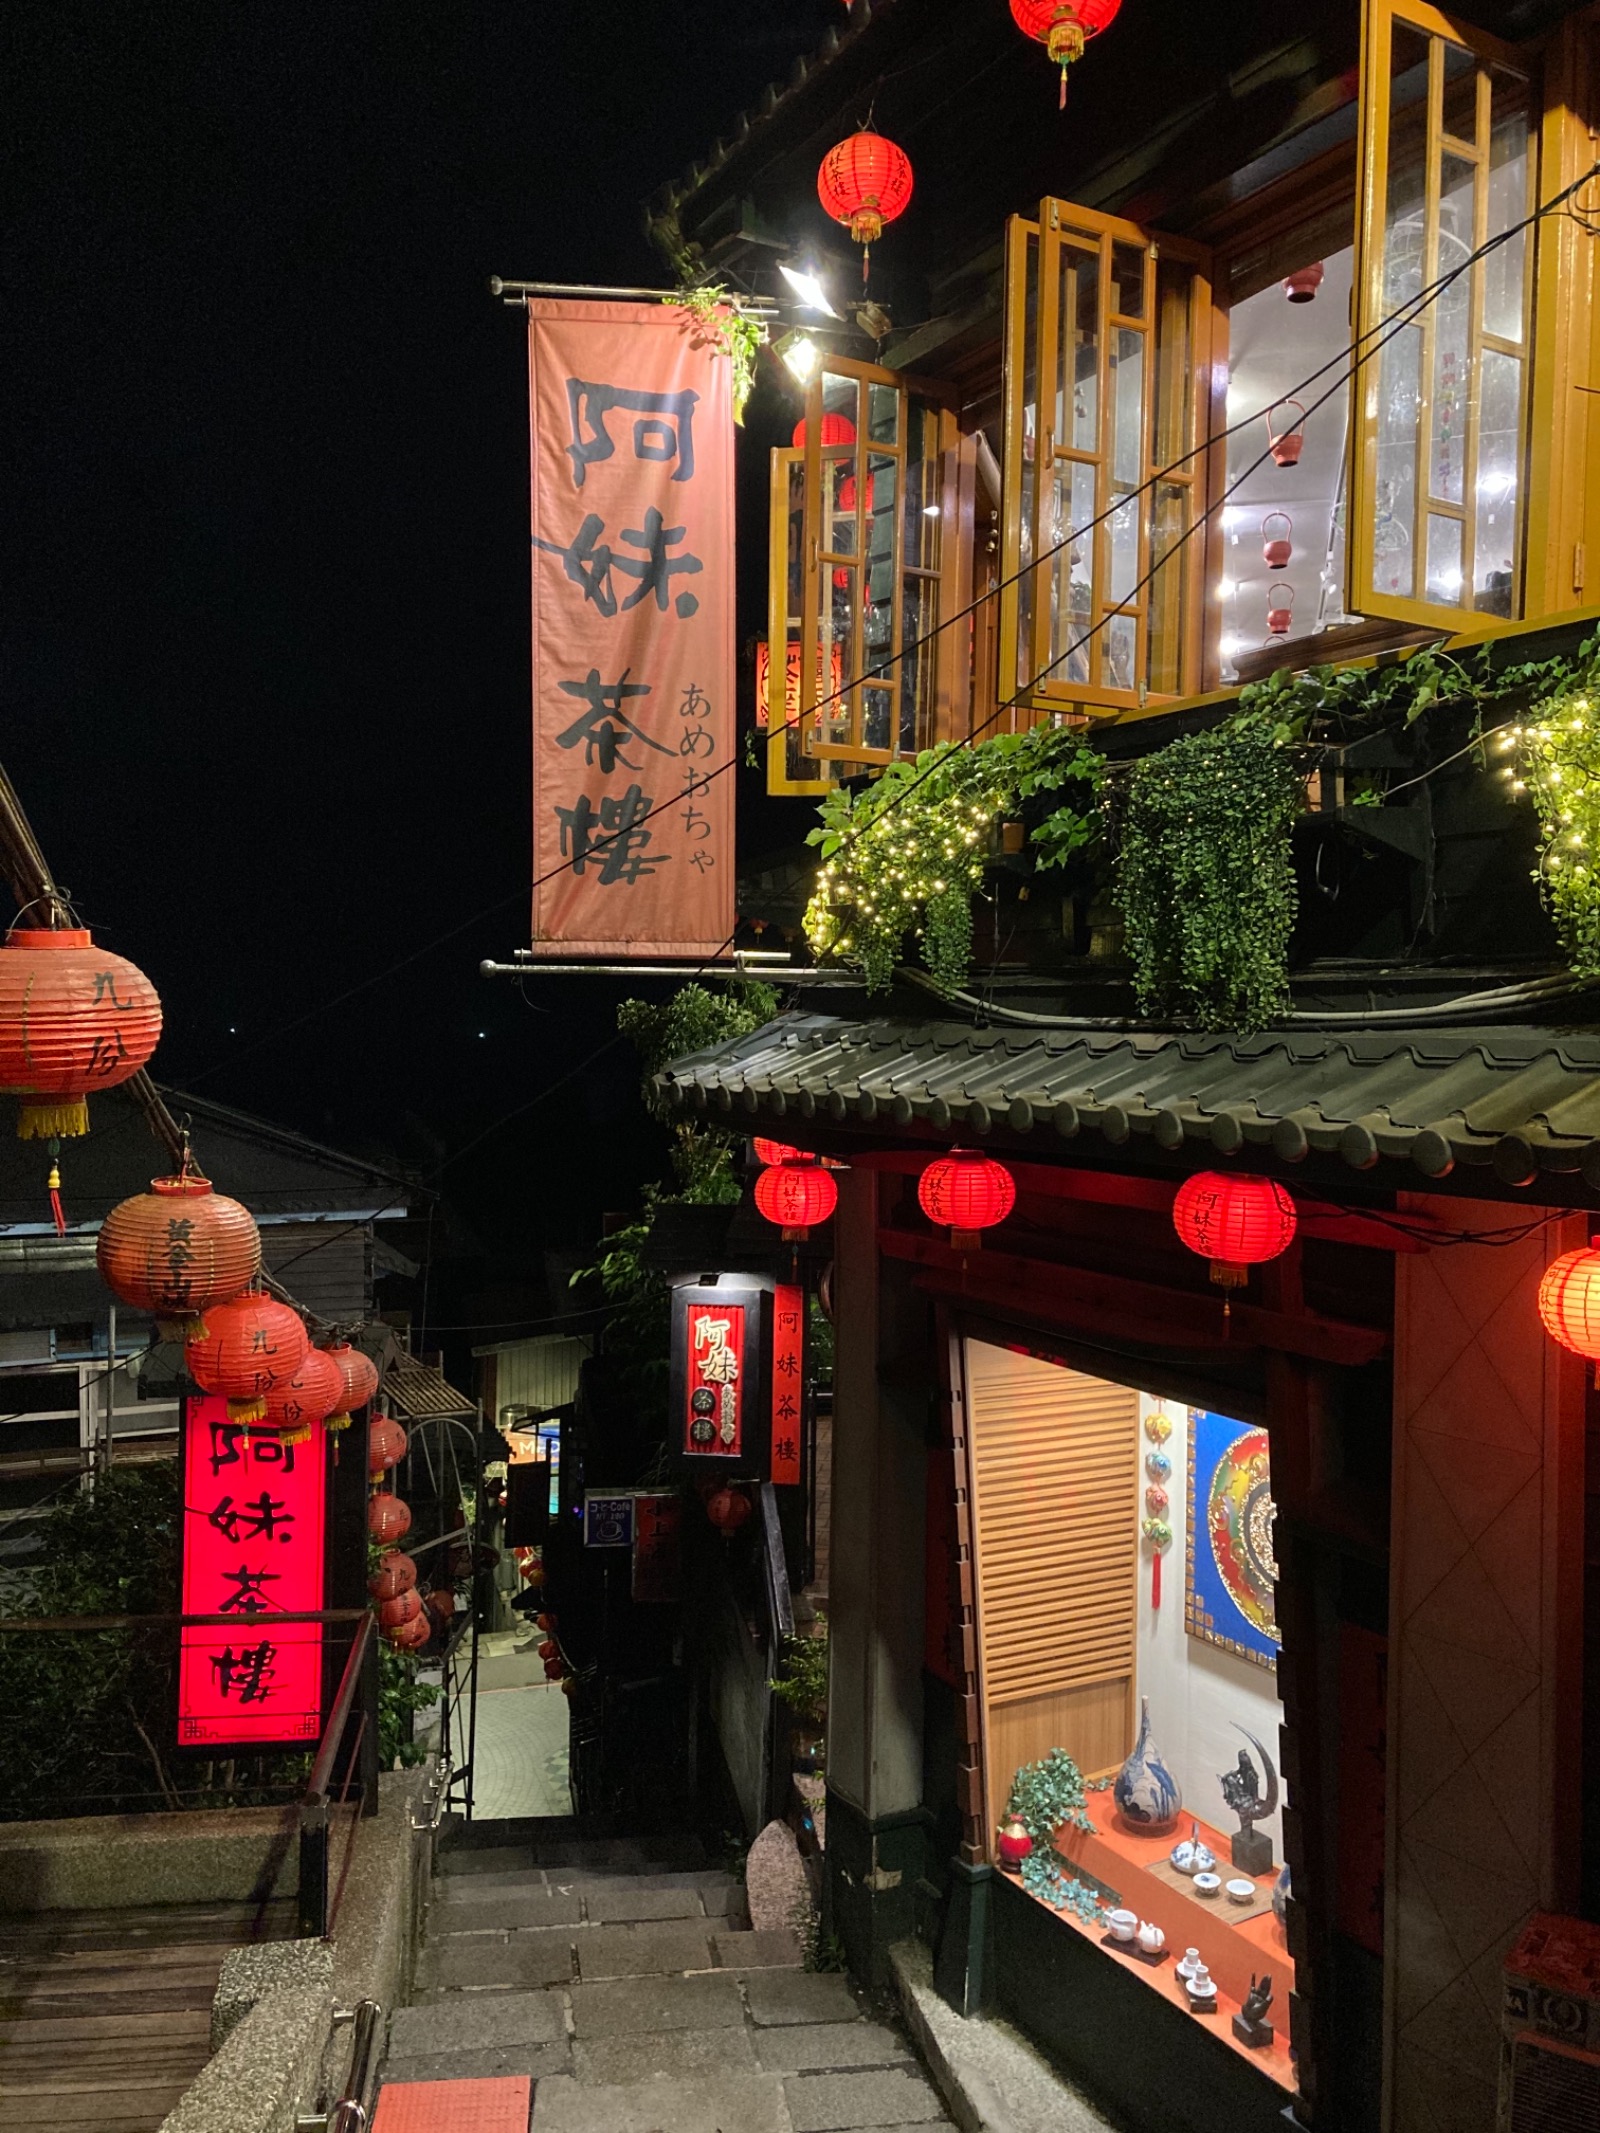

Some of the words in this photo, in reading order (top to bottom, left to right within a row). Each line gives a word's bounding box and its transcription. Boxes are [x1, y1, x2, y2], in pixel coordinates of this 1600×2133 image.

[532, 376, 704, 885] 阿妹茶樓
[679, 682, 715, 875] あめおちゃ
[85, 970, 134, 1077] 九份
[252, 1329, 278, 1393] 九份
[694, 1314, 739, 1384] 阿妹
[775, 1311, 799, 1463] 阿妹茶樓
[185, 1421, 296, 1705] 阿妹茶樓
